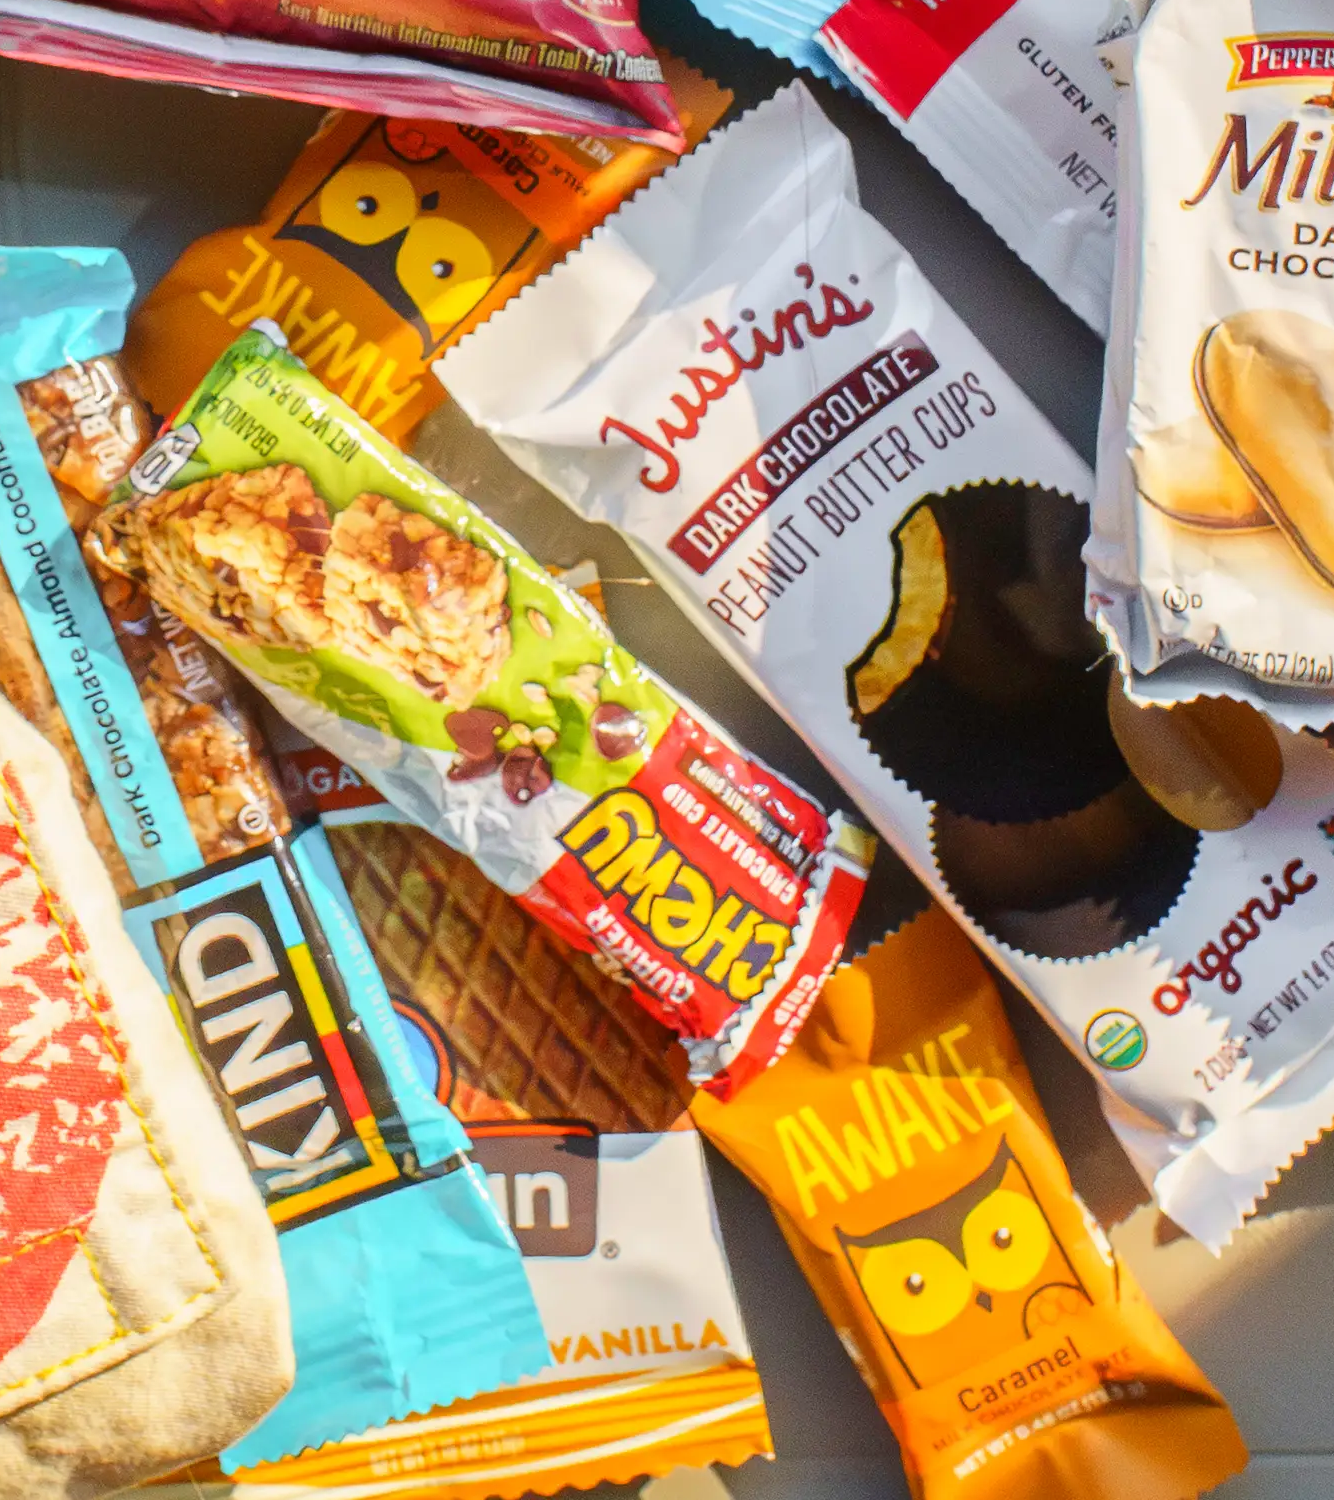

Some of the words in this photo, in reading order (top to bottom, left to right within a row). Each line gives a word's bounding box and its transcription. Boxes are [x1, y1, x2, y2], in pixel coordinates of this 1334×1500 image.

[315, 4, 395, 40] Nutrition
[398, 15, 501, 61] Information
[504, 38, 531, 66] for
[535, 42, 581, 73] Total
[1016, 36, 1094, 115] GLUTEN
[1090, 112, 1118, 147] FR
[1058, 150, 1109, 197] NET
[197, 234, 425, 430] AWAKE
[243, 363, 274, 390] OZ
[600, 261, 876, 495] Justin's
[684, 471, 768, 561] DARK
[760, 344, 922, 489] CHOCOLATE
[707, 515, 822, 639] PEANUT
[817, 424, 926, 539] BUTTER
[914, 370, 999, 451] CUPS
[22, 540, 84, 641] Almond
[60, 640, 139, 789] Chocolate
[116, 784, 163, 851] Dark
[661, 782, 707, 825] CHIP
[699, 814, 799, 906] CHOCOLATE
[584, 902, 696, 1005] QUAKER
[1151, 856, 1319, 1017] organic
[772, 973, 817, 1025] CHIP
[1192, 1069, 1215, 1093] 2
[1246, 1003, 1284, 1041] NET
[1279, 979, 1312, 1015] WT
[177, 910, 355, 1193] KIND
[773, 1023, 1016, 1220] AWAKE
[548, 1317, 730, 1366] VANILLA
[957, 1335, 1083, 1413] Caramel
